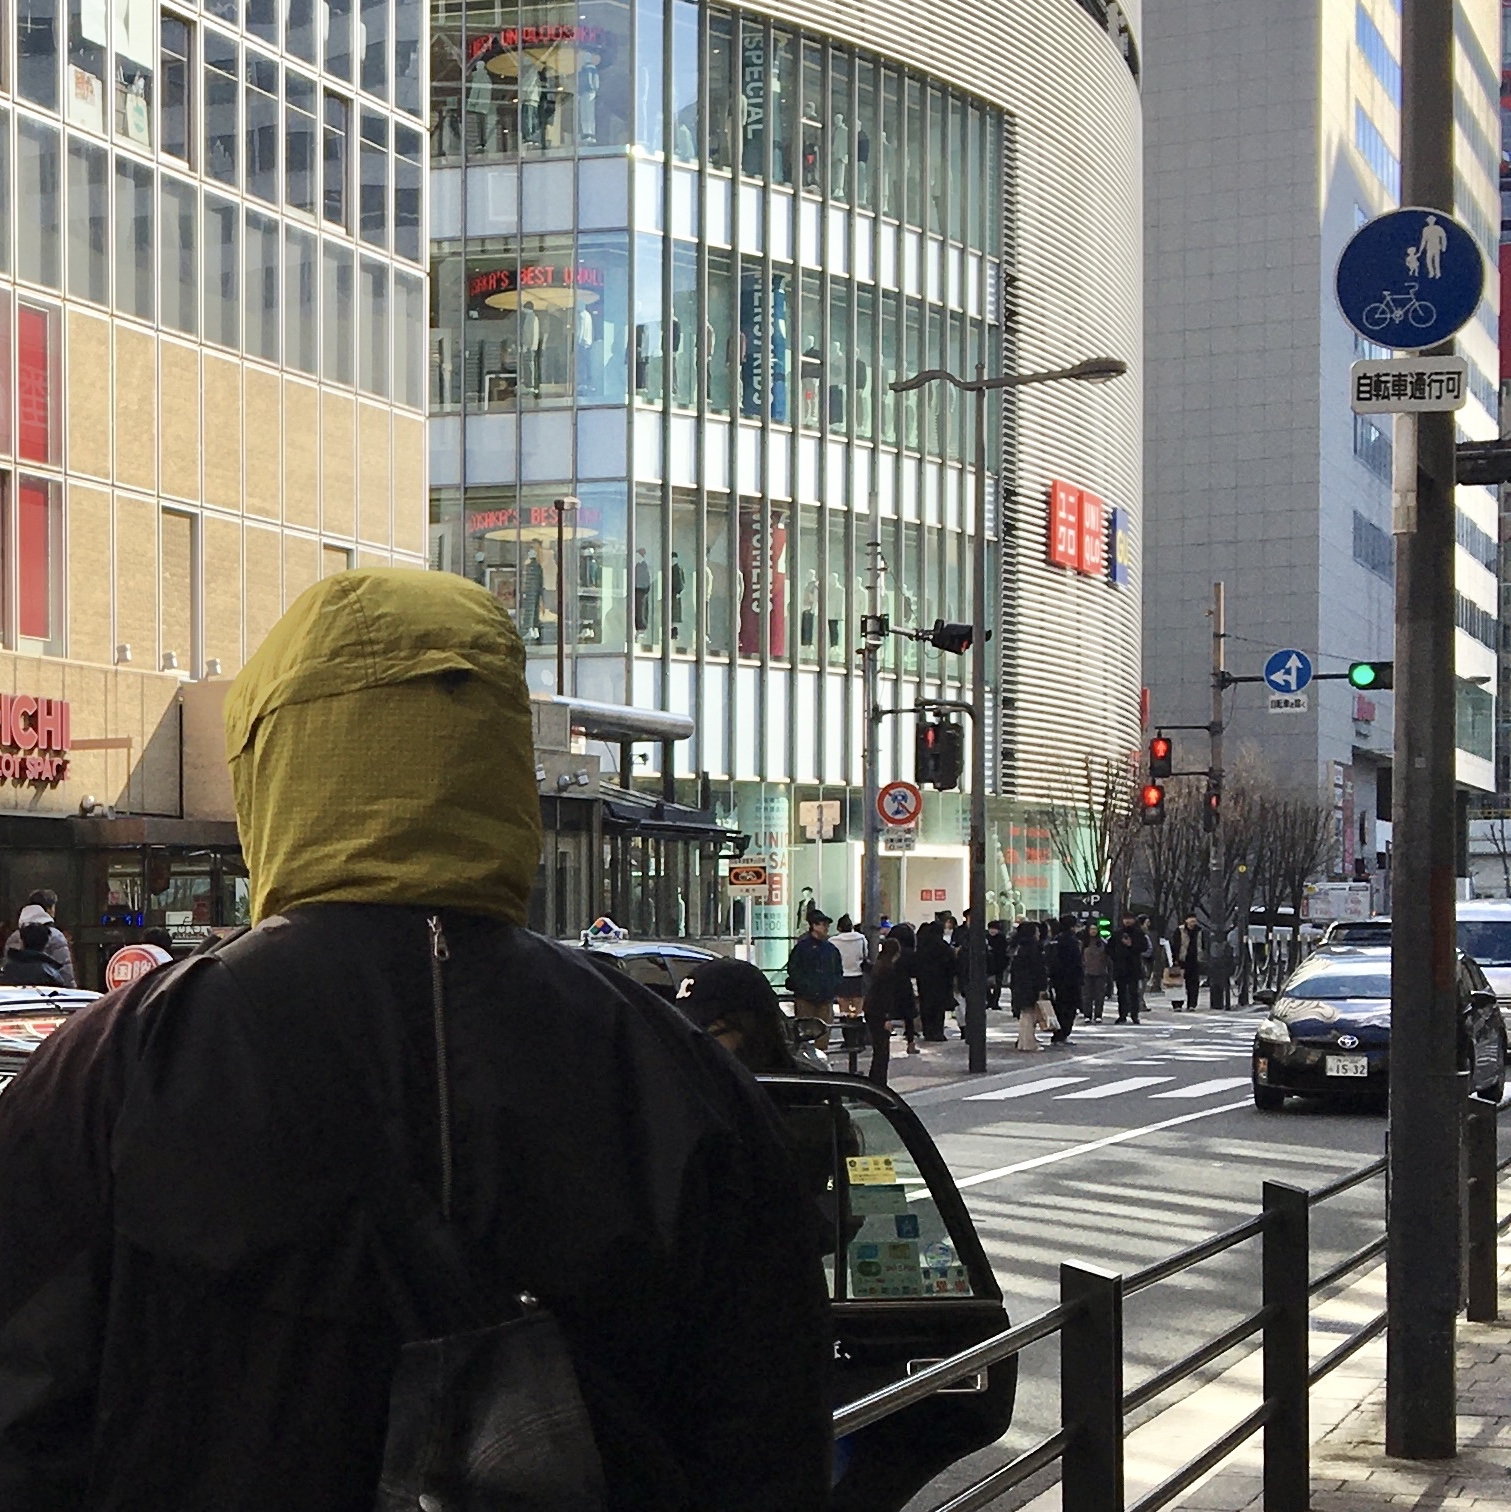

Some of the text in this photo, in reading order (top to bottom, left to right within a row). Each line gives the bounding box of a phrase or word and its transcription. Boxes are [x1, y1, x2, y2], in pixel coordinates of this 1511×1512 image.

[744, 36, 764, 139] SPECIAL
[1355, 370, 1463, 402] 自転車通行可
[25, 756, 71, 781] SPACE
[754, 831, 788, 849] UNI
